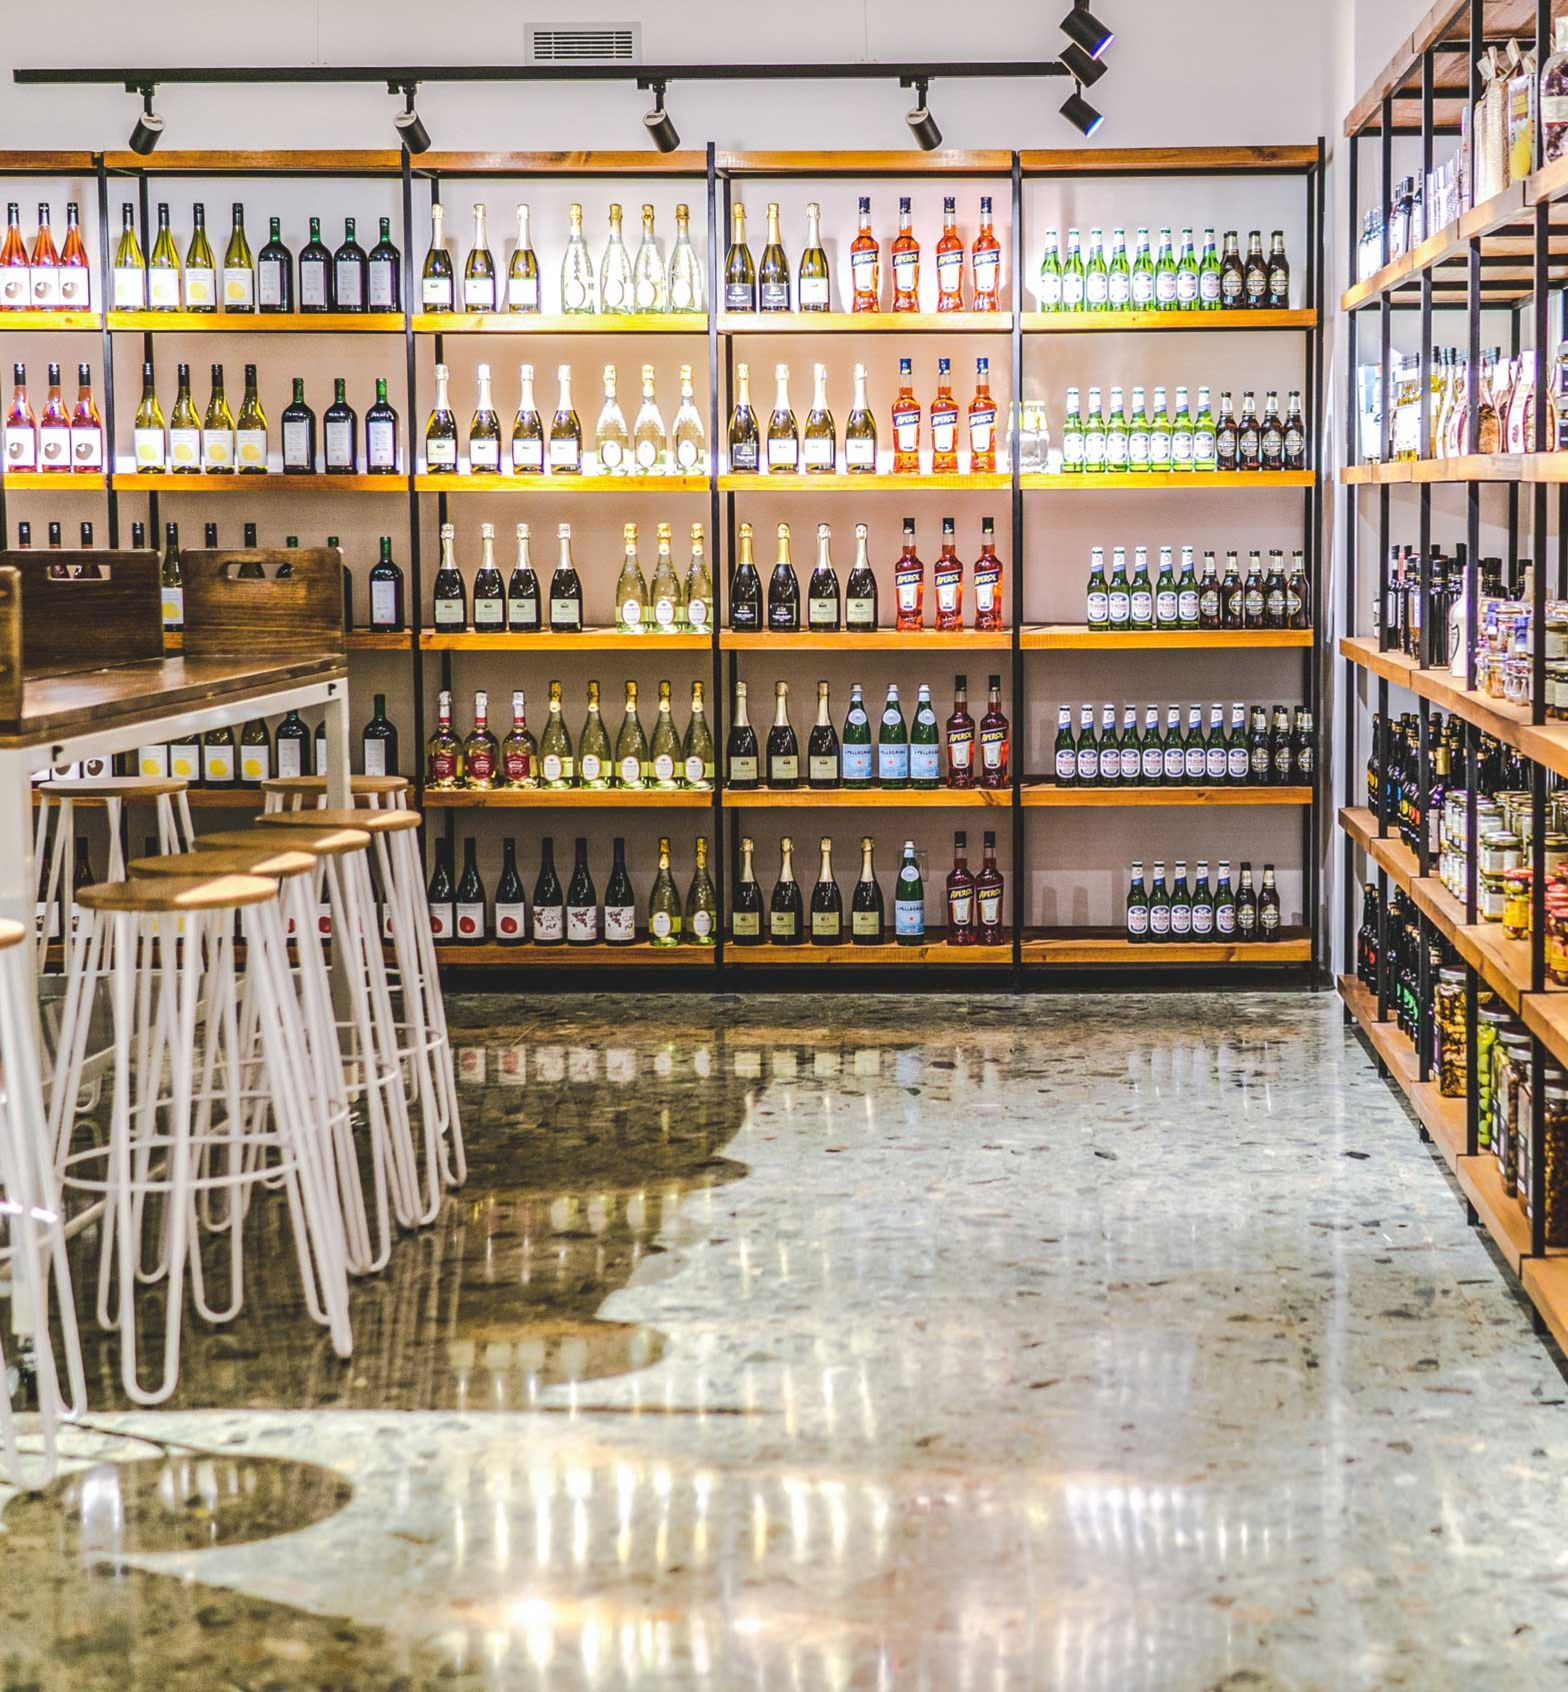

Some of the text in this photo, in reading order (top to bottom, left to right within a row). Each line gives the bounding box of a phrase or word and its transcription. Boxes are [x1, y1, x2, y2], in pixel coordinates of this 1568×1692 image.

[853, 254, 877, 266] APEROL
[894, 254, 918, 266] APEROL
[938, 254, 962, 266] APEROL
[974, 254, 998, 266] APEROL
[896, 415, 920, 426] APEROL
[932, 414, 957, 426] APEROL
[970, 414, 994, 426] APEROL
[897, 573, 920, 585] APEROL
[936, 573, 960, 585] APEROL
[975, 573, 997, 585] APEROL
[949, 731, 973, 743] APEROL
[981, 731, 1004, 743] APEROL
[950, 888, 973, 899] APEROL
[979, 888, 1001, 899] APEROL
